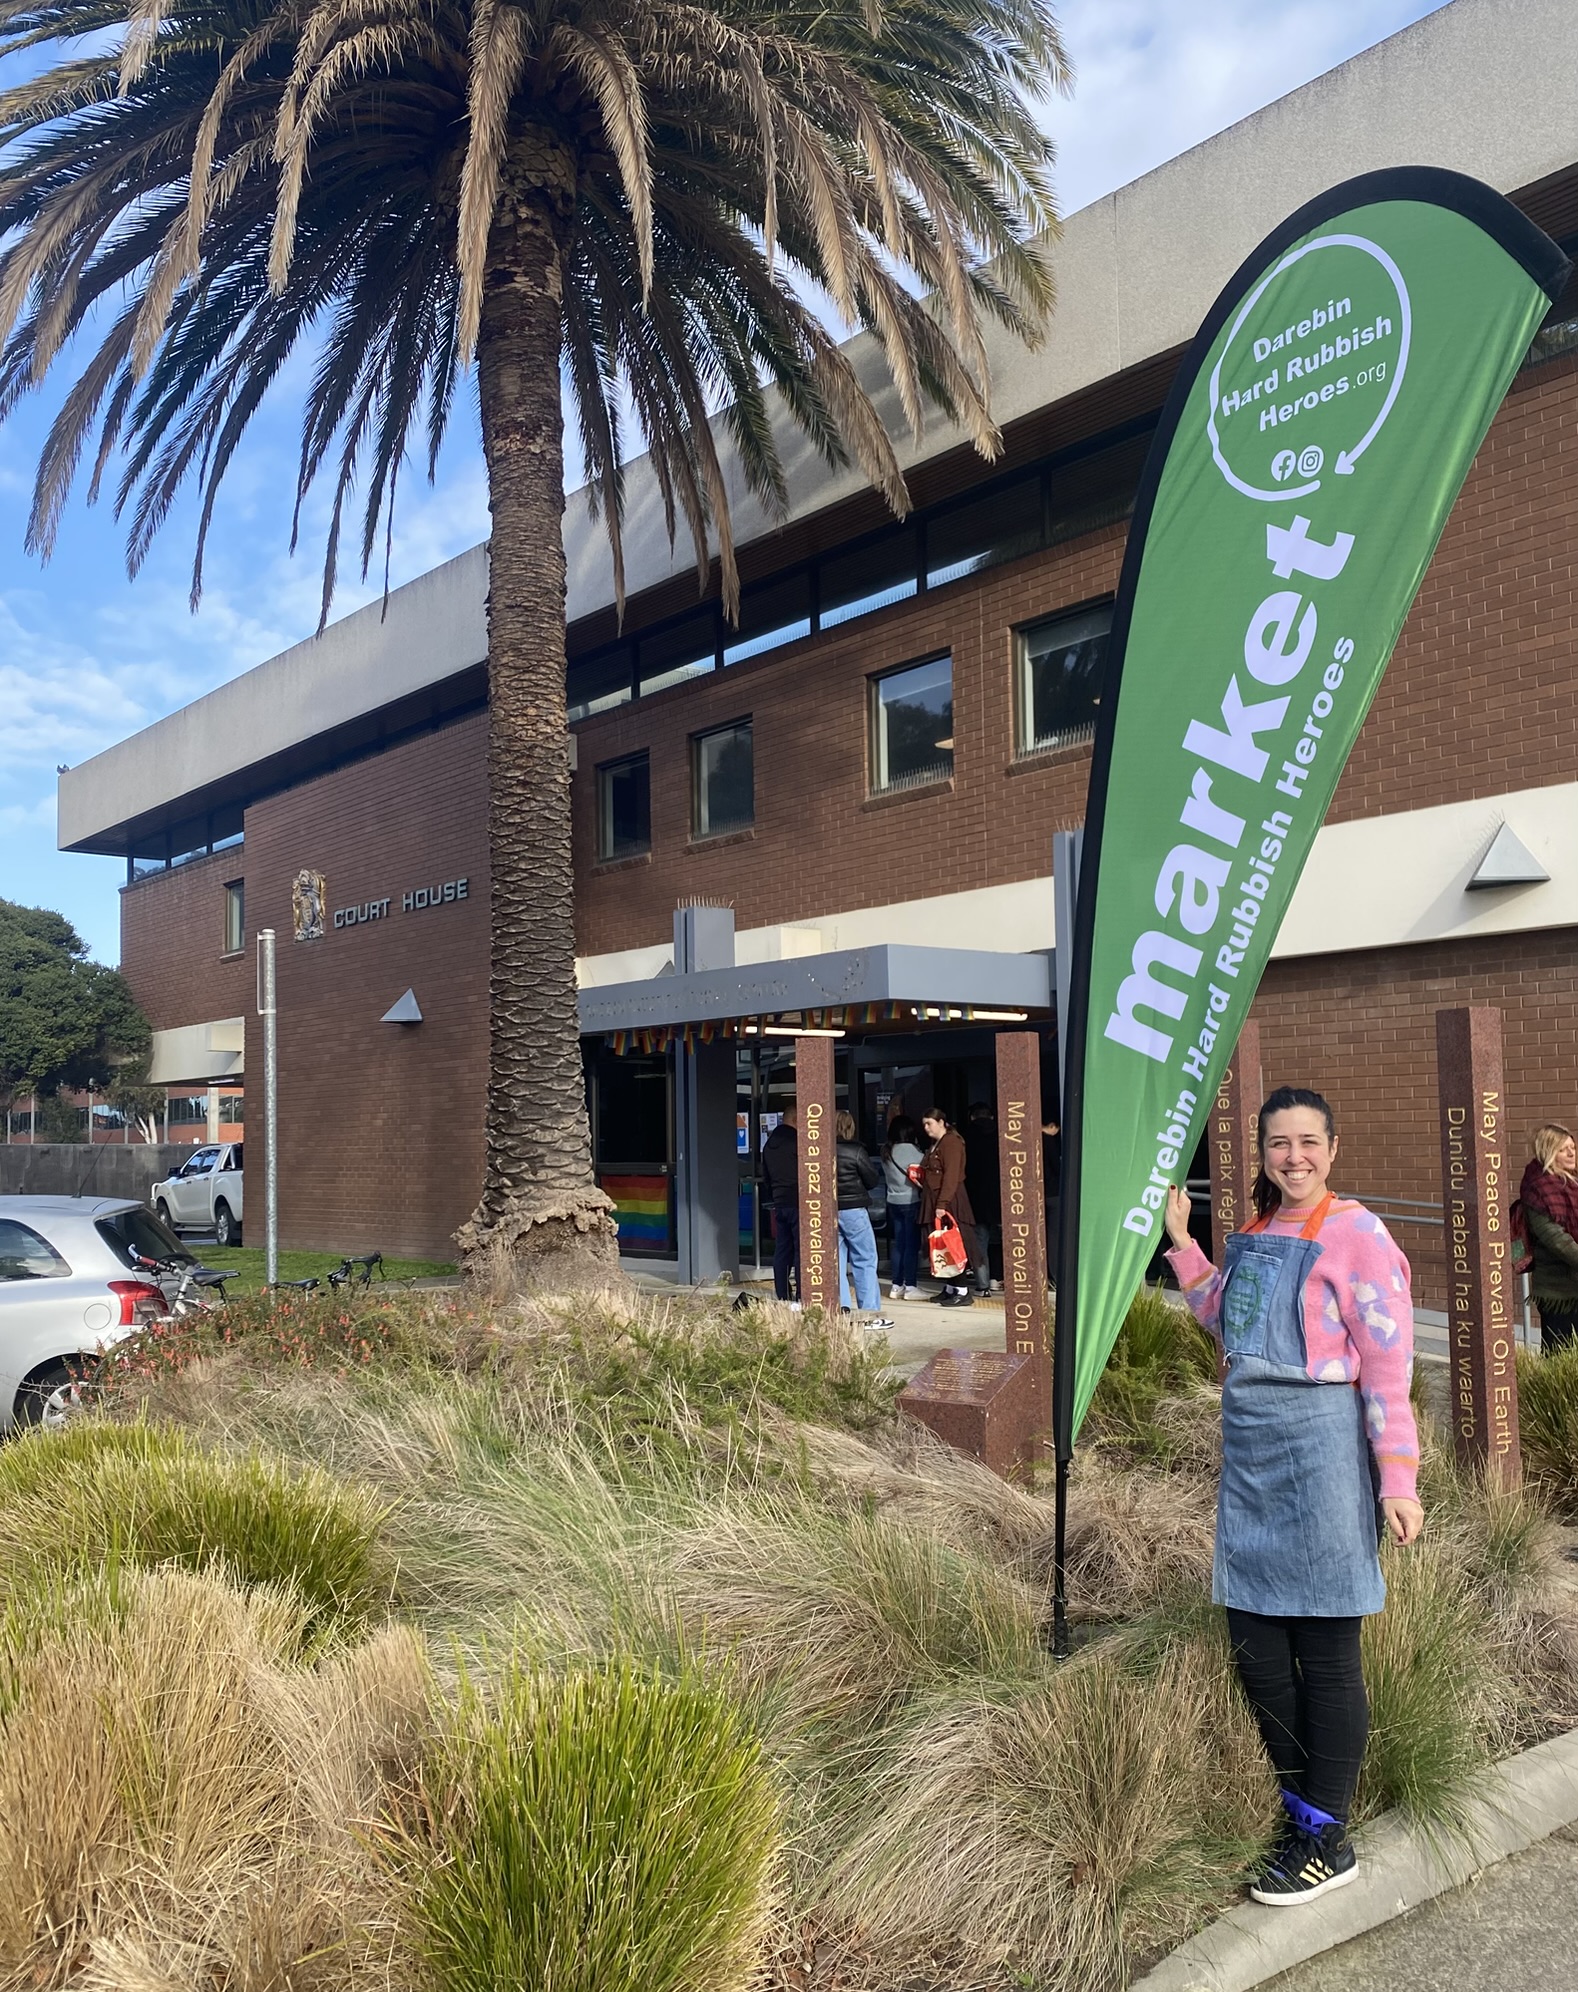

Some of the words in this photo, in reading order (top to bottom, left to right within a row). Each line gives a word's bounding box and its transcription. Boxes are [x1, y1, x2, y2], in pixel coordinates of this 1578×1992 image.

[1253, 297, 1351, 362] Darebin
[1221, 369, 1279, 417] Hard
[1286, 315, 1392, 382] Rubbish
[1103, 514, 1355, 1063] market
[333, 897, 391, 929] COURT
[402, 877, 469, 913] HOUSE
[1122, 1089, 1198, 1237] Darebin
[1182, 983, 1231, 1082] Hard
[1215, 810, 1293, 978] Rubbish
[1275, 636, 1355, 799] Heroes
[806, 1103, 823, 1140] Que
[1004, 1101, 1025, 1143] May
[1218, 1117, 1234, 1133] la
[1448, 1107, 1468, 1190] Dunidu
[1480, 1091, 1499, 1143] May
[804, 1162, 821, 1194] paz
[808, 1145, 820, 1157] a
[1009, 1151, 1027, 1215] Peace
[1216, 1140, 1236, 1181] paix
[1485, 1153, 1501, 1232] Peace
[806, 1200, 826, 1286] prevaleça
[1011, 1223, 1032, 1294] Prevail
[1451, 1199, 1472, 1274] nabad
[1015, 1302, 1033, 1332] On
[1455, 1283, 1472, 1312] ha
[1488, 1242, 1508, 1329] Prevail
[1456, 1320, 1474, 1348] ku
[1492, 1339, 1509, 1376] On
[1458, 1357, 1478, 1438] waarto
[1494, 1386, 1512, 1455] Earth
